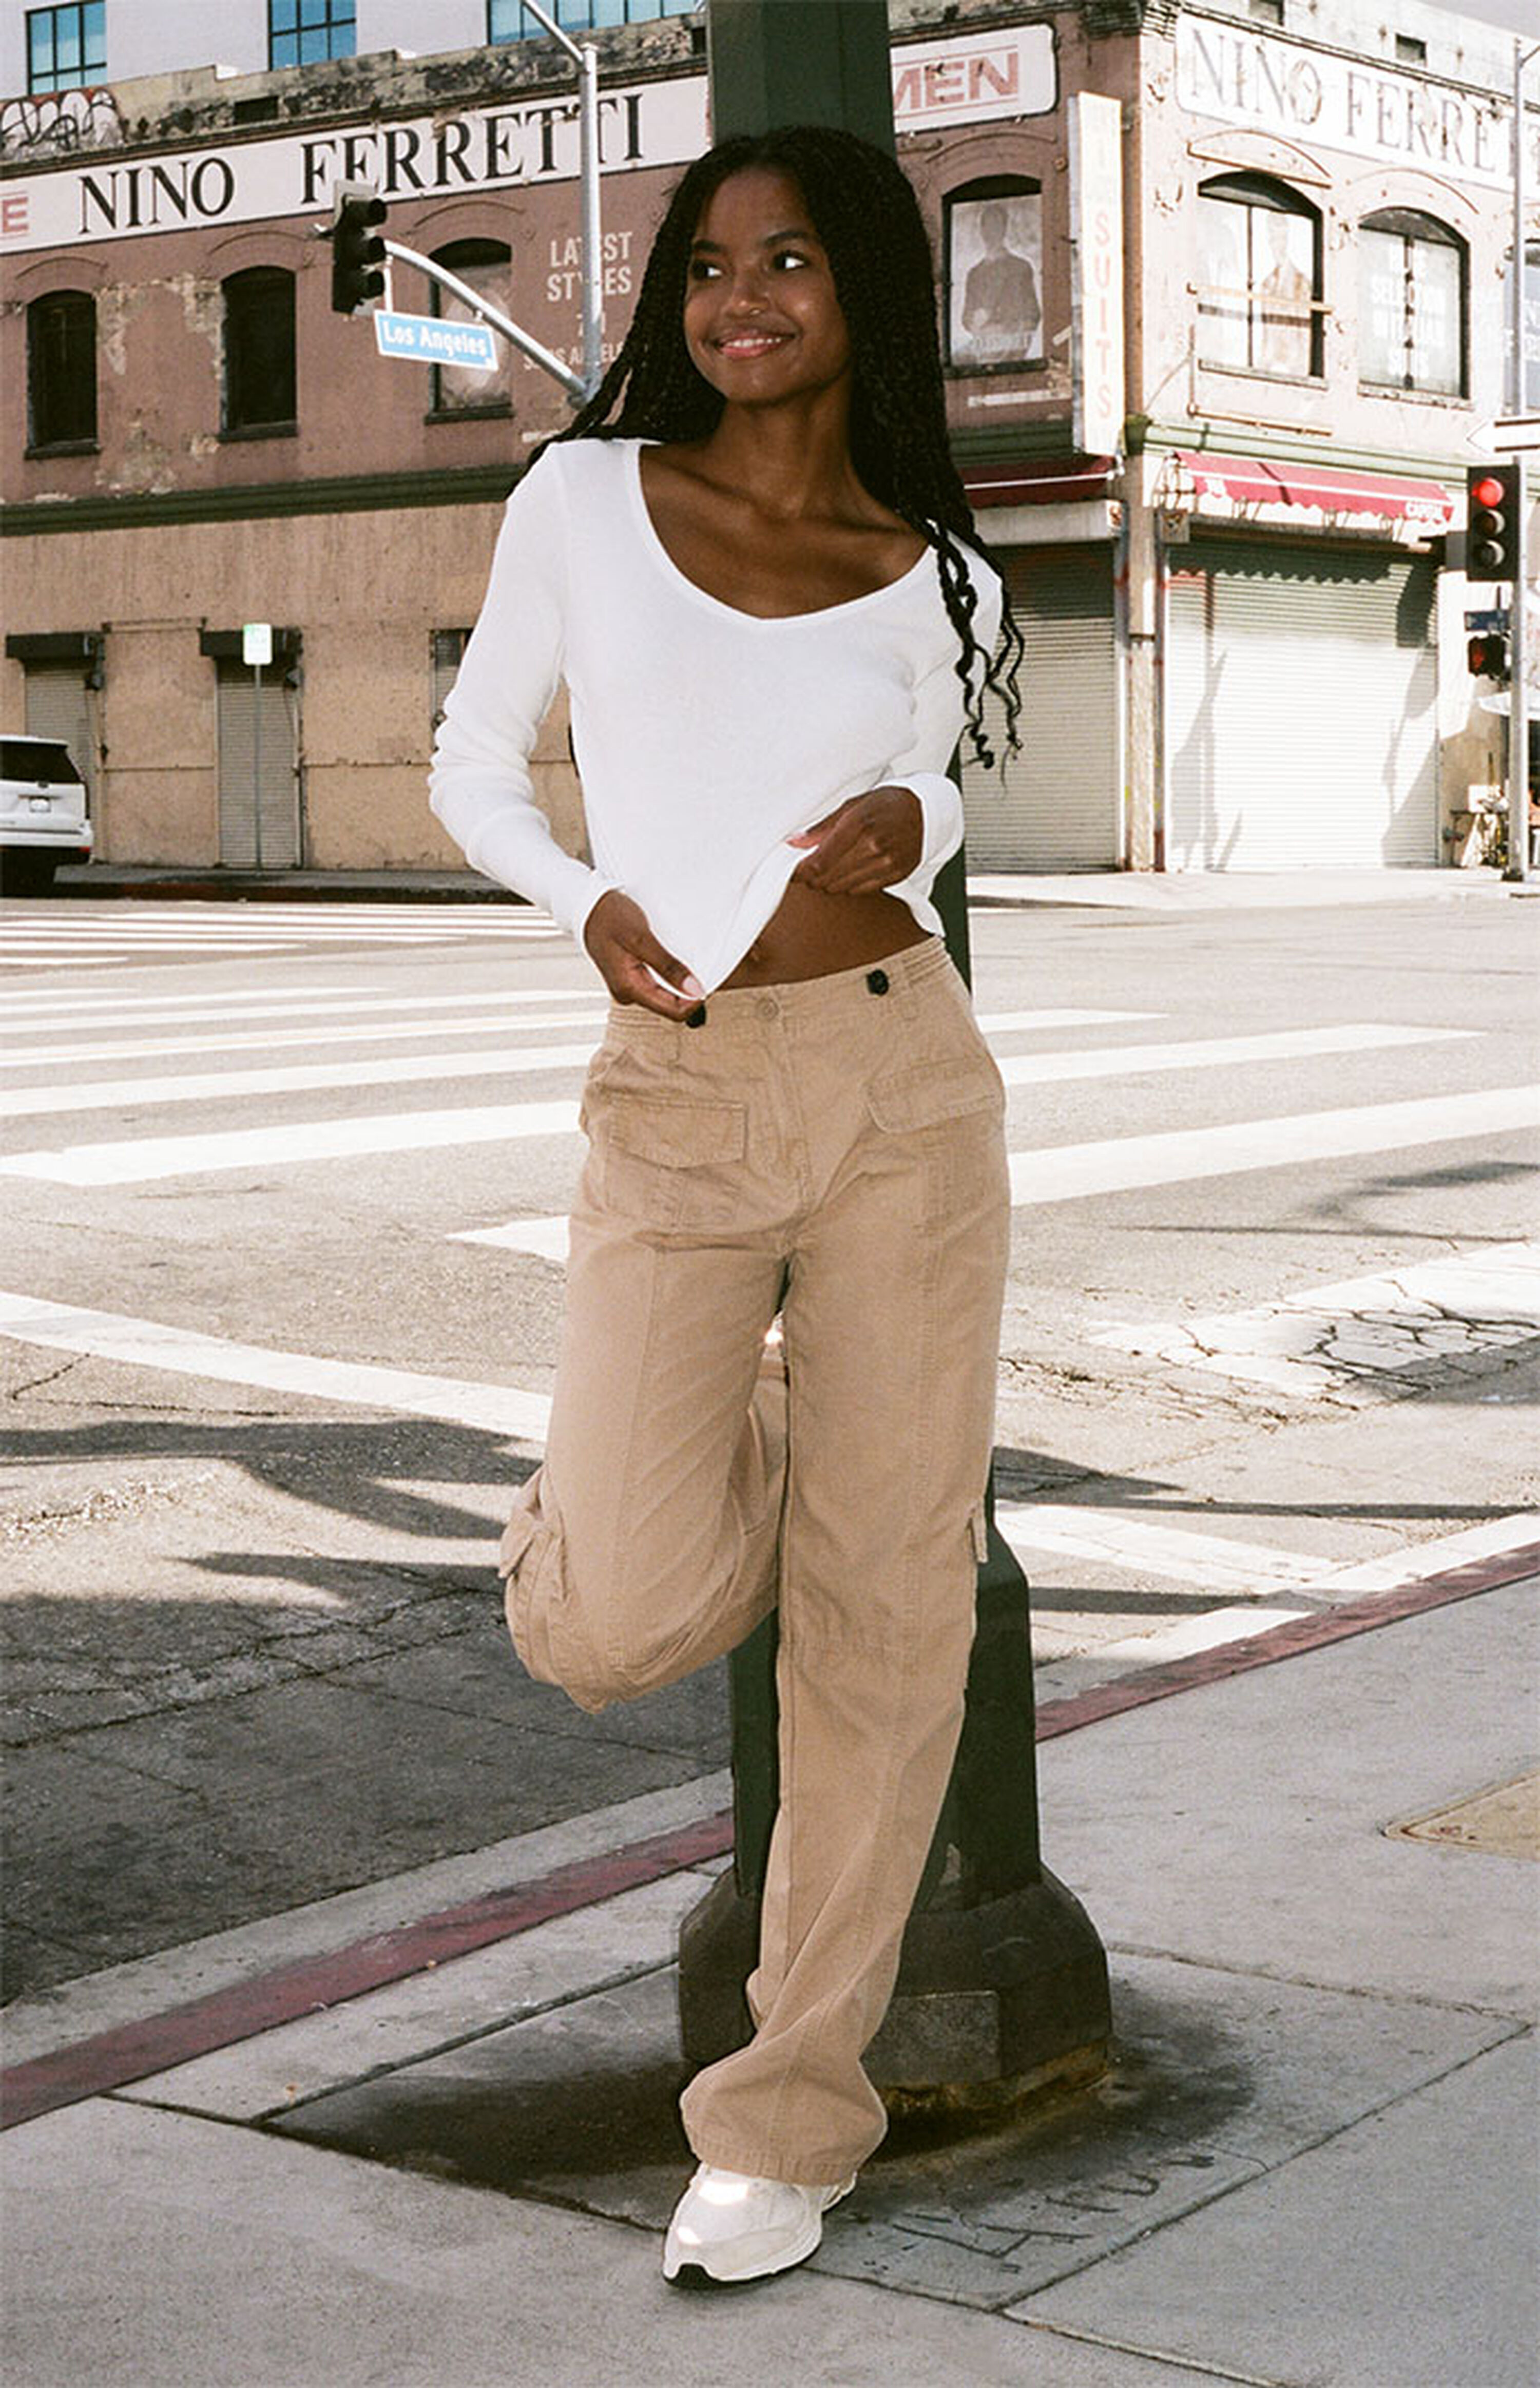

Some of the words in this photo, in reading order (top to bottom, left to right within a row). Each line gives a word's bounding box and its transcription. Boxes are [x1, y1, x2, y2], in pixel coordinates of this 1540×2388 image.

[1190, 29, 1321, 124] NINO
[79, 157, 235, 235] NINO
[550, 232, 632, 267] LAST
[546, 267, 632, 302] STES
[382, 320, 414, 345] Los
[419, 325, 487, 357] Angeles
[1093, 211, 1112, 420] SUITS
